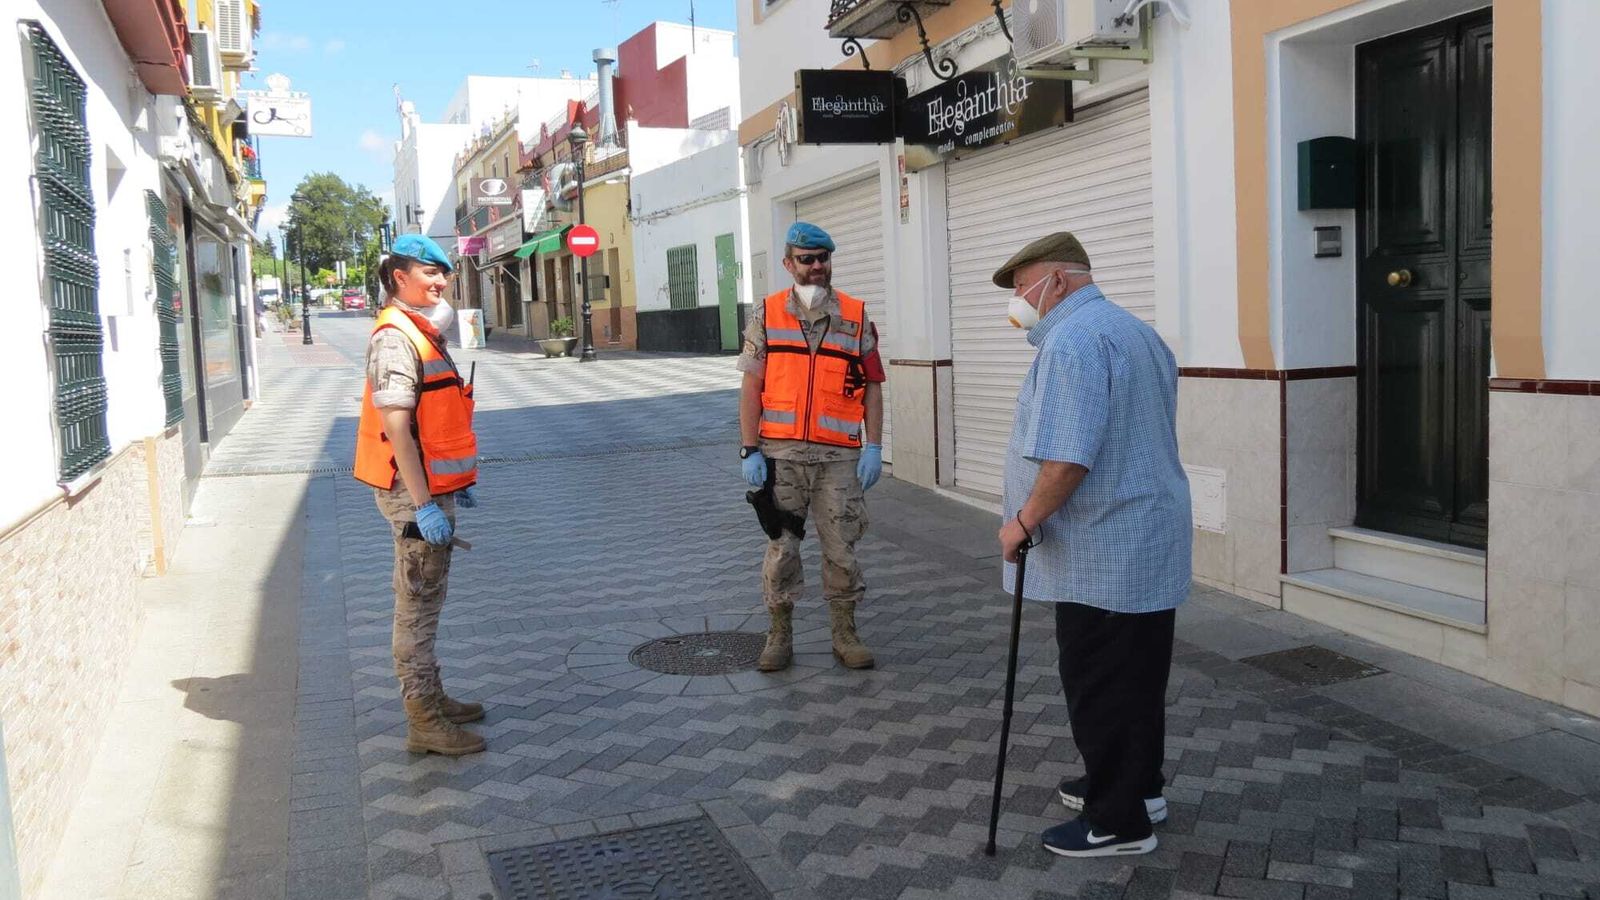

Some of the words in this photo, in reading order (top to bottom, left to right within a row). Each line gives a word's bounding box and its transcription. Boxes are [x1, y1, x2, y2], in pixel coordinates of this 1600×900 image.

[812, 94, 886, 115] Eleganthia
[926, 57, 1033, 137] Eleganthia
[937, 139, 955, 153] moda
[964, 119, 1015, 145] complementos
